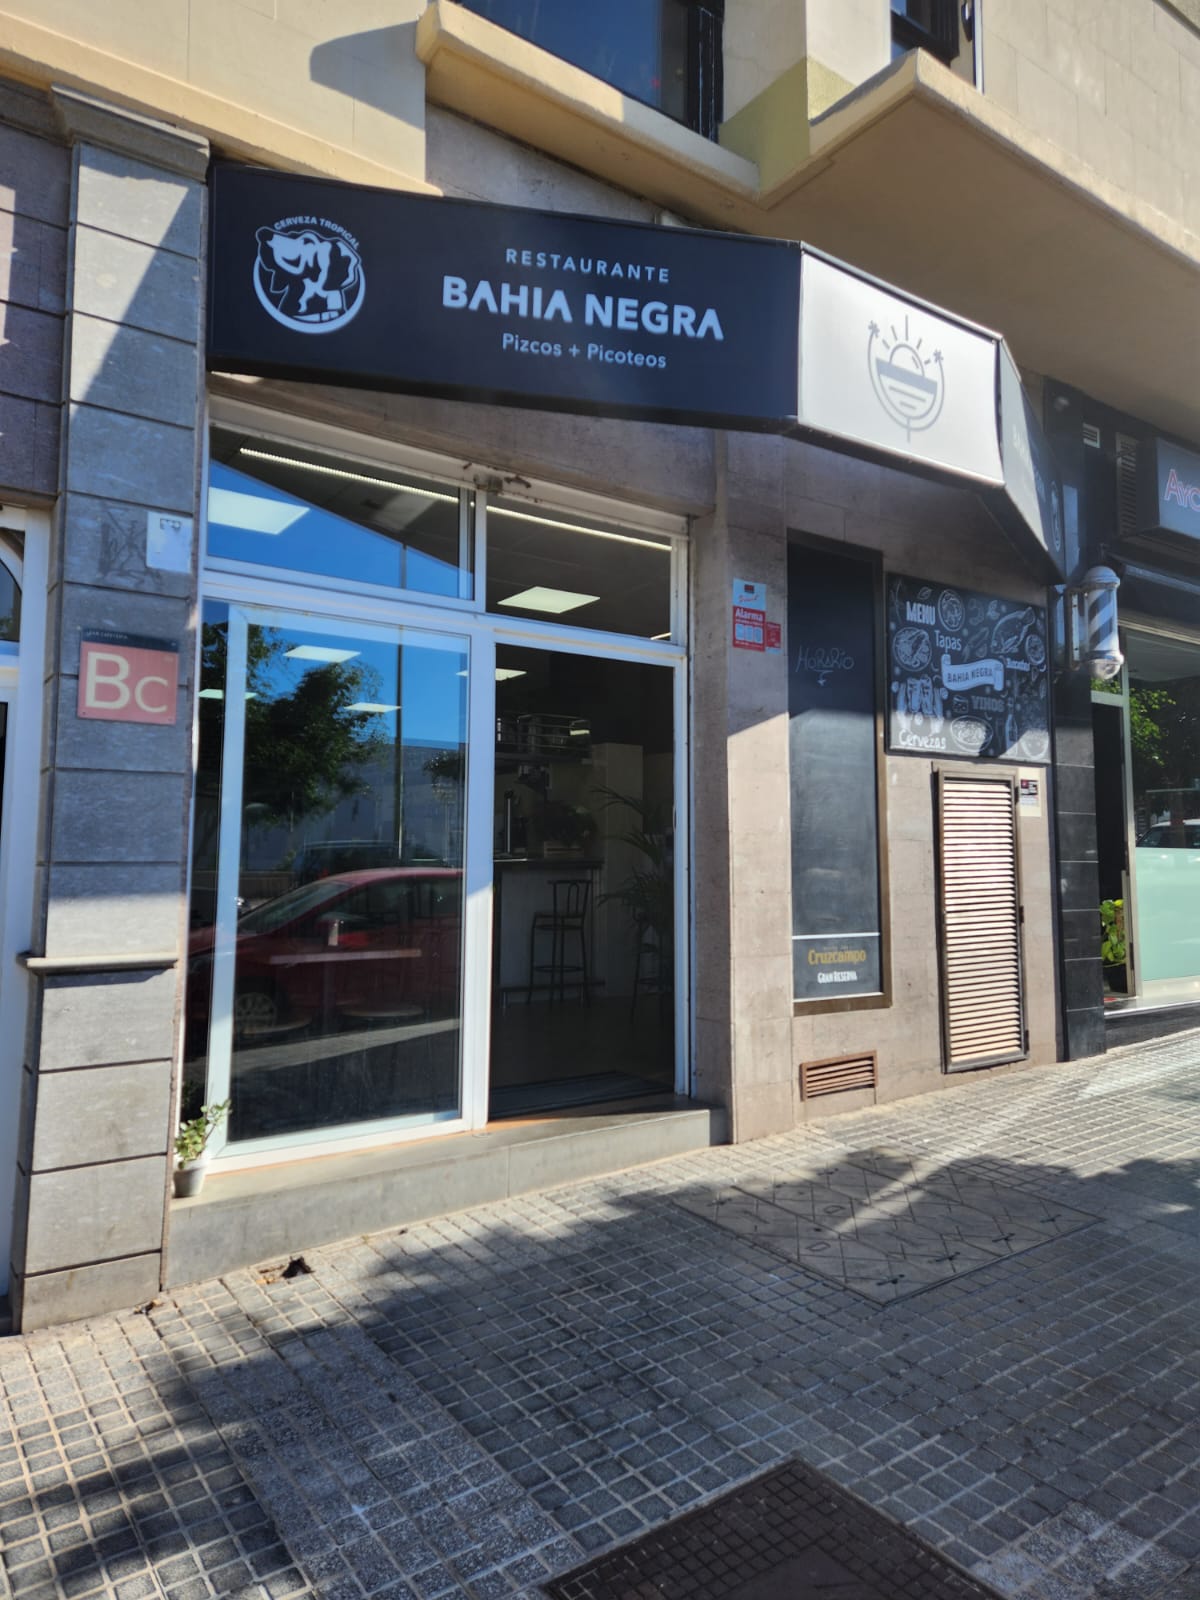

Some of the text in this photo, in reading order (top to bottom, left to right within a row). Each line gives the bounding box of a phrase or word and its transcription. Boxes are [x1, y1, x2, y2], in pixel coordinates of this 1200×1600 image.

[273, 216, 360, 250] CERVEZA TROPICAL
[505, 247, 670, 284] RESTAURANTE
[442, 275, 724, 341] BAHIA NEGRA
[502, 332, 562, 358] Pizcos
[587, 343, 667, 369] Picoteos
[906, 601, 936, 626] MENU
[934, 629, 962, 653] Tapas
[947, 667, 993, 684] BAHIA NEGRA
[898, 729, 947, 750] Cervezas
[808, 949, 867, 965] Cruzcampo
